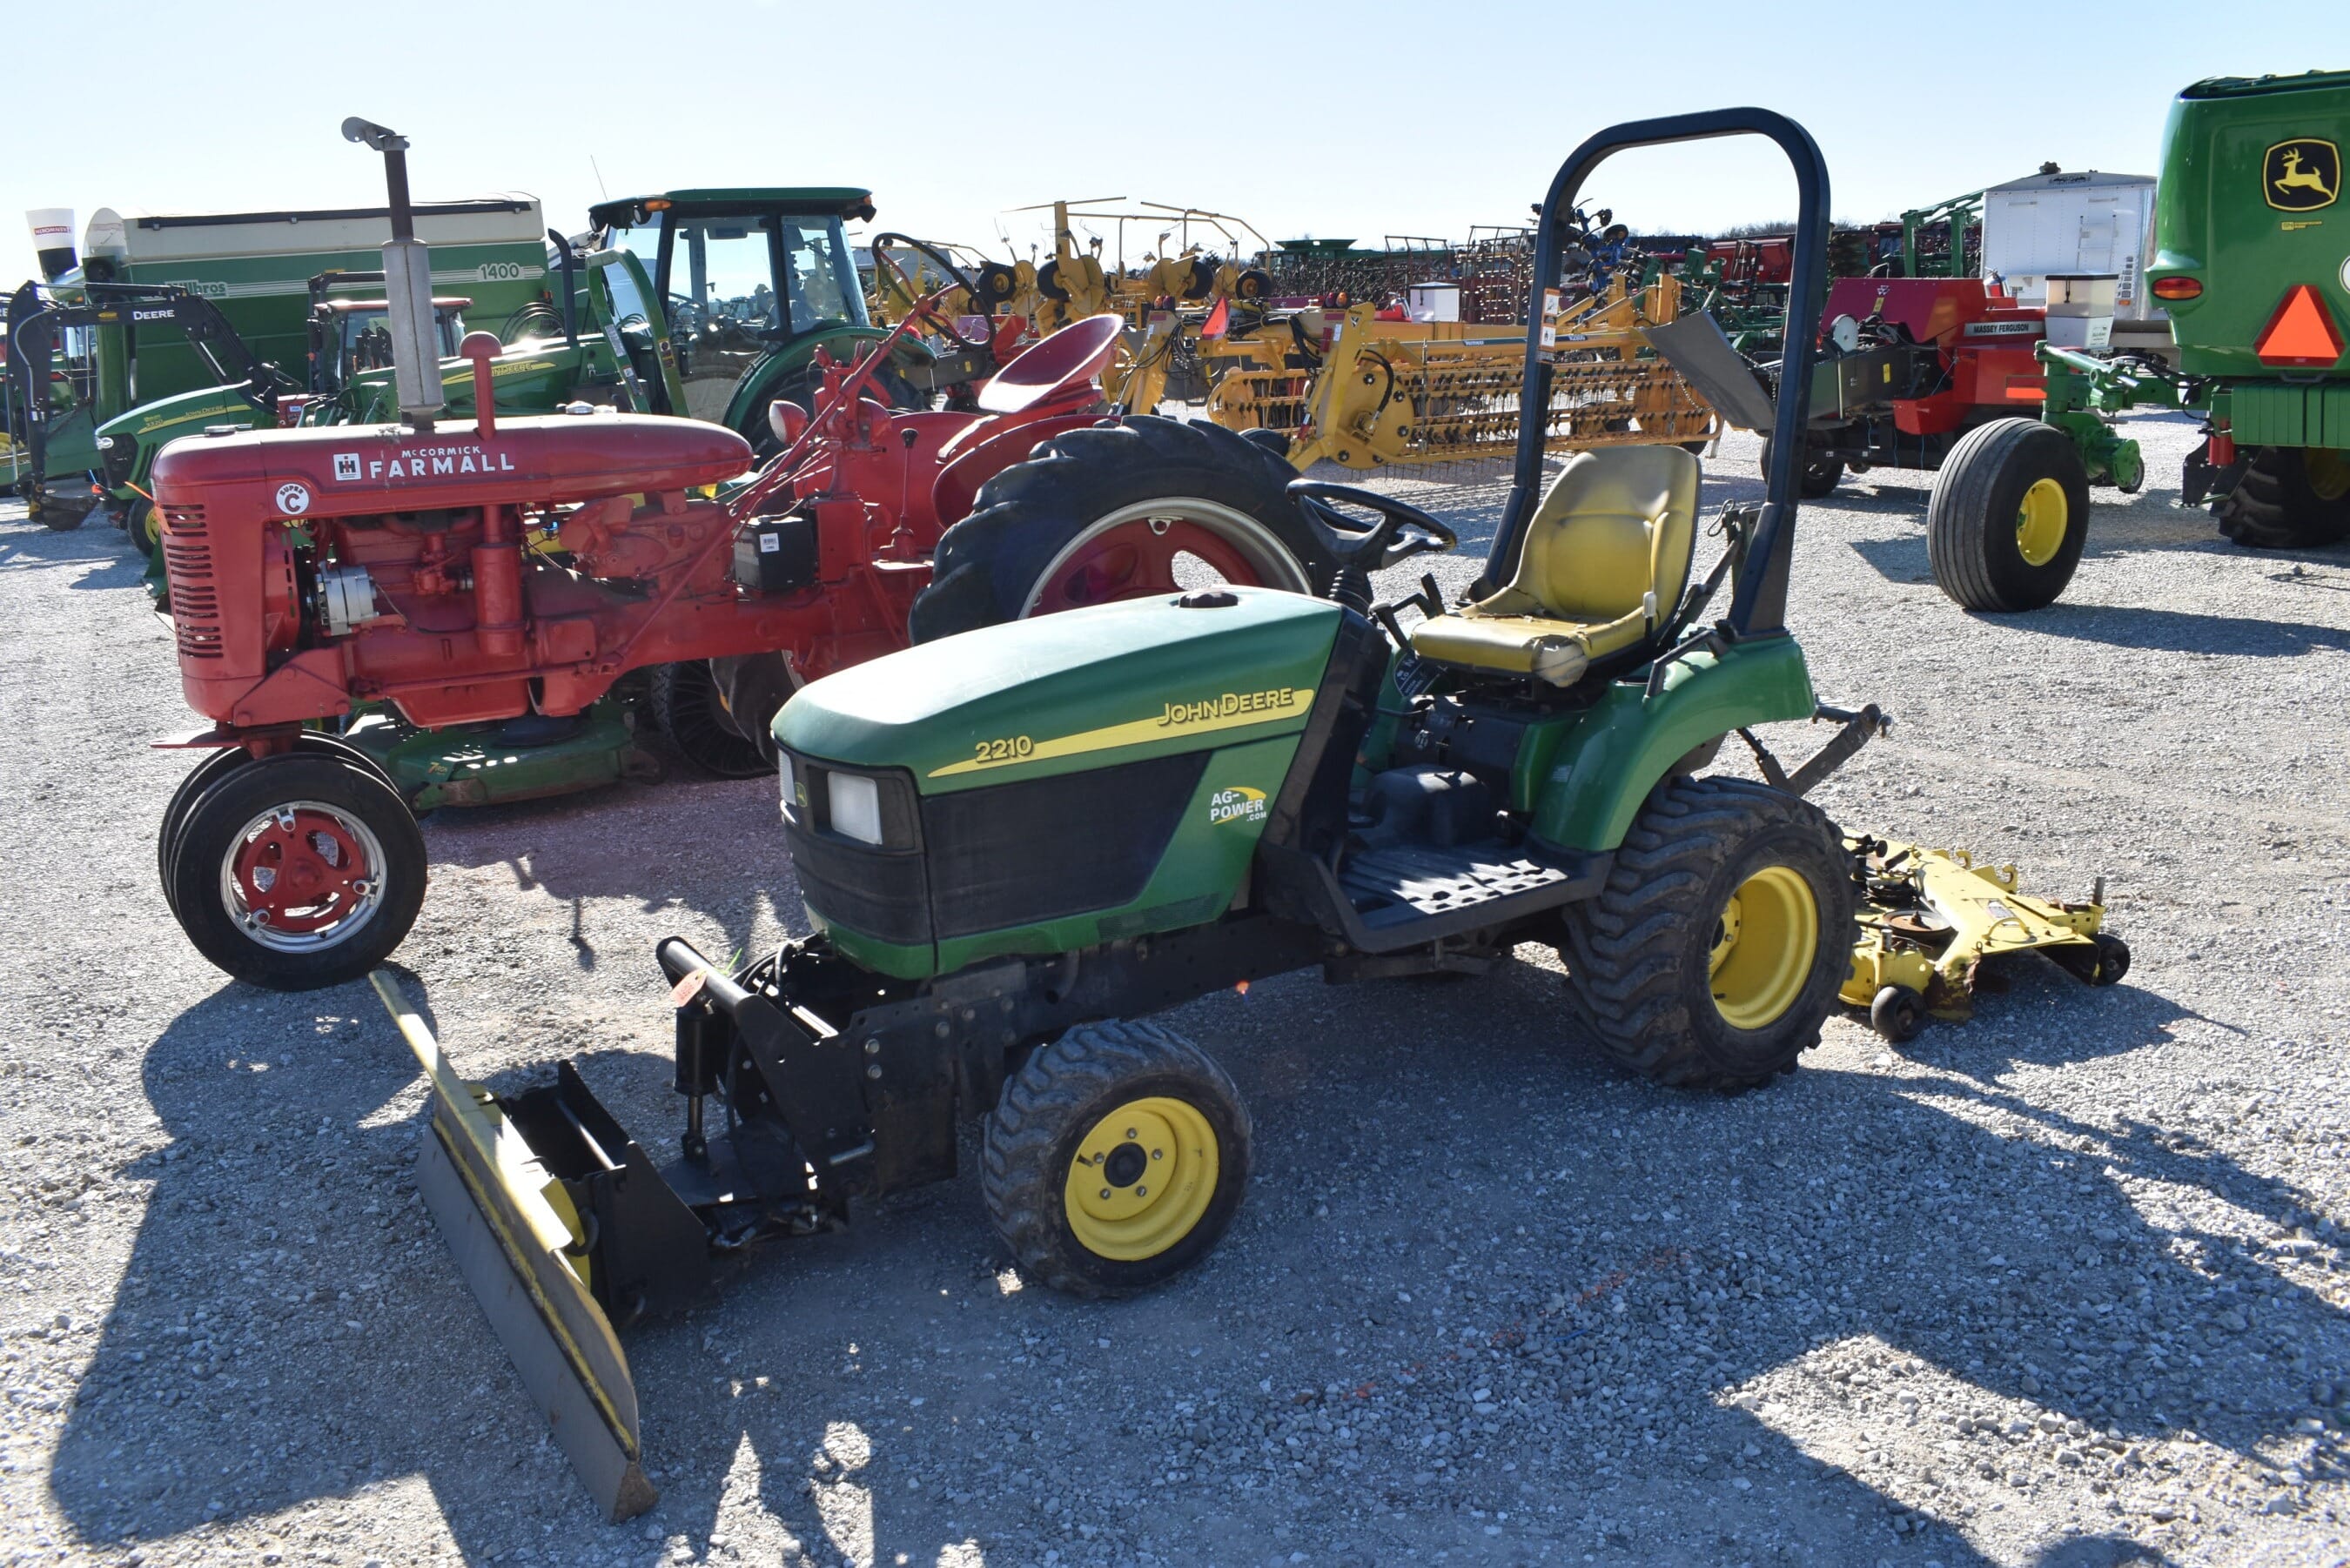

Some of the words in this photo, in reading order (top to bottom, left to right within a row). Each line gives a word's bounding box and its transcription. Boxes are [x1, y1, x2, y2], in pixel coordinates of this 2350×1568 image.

[480, 265, 520, 279] 1400
[133, 310, 175, 320] DEERE
[1974, 325, 1998, 333] MASSEY
[1998, 323, 2029, 332] FERGUSON
[401, 446, 481, 459] McCORMICK
[369, 453, 514, 479] FARMALL
[279, 485, 304, 496] SUPER
[285, 493, 301, 512] C
[1157, 700, 1219, 727] JOHN
[1220, 687, 1294, 714] DEERE
[975, 735, 1034, 763] 2210
[1211, 791, 1240, 807] AG-
[1211, 799, 1264, 821] POWER
[1246, 811, 1267, 821] .COM
